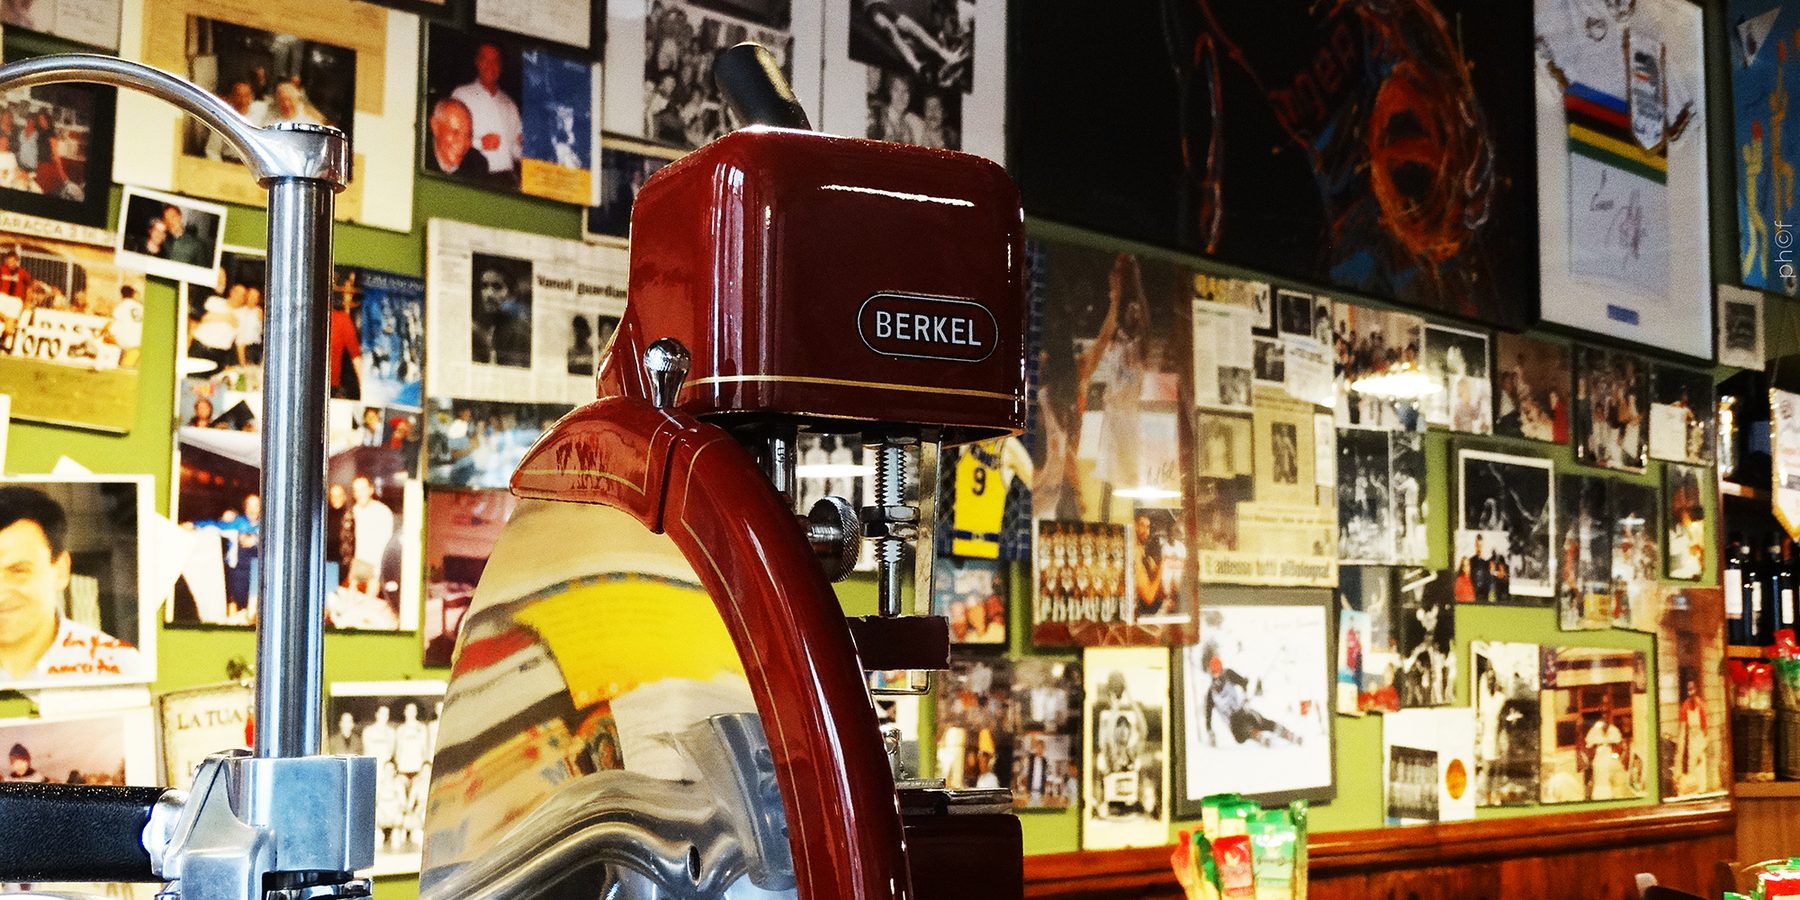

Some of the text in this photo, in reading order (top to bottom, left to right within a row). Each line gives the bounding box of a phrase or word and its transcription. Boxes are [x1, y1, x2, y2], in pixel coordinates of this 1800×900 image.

[876, 310, 982, 346] BERKEL
[972, 467, 986, 496] 9
[177, 713, 202, 731] LA
[206, 708, 244, 727] TUA
